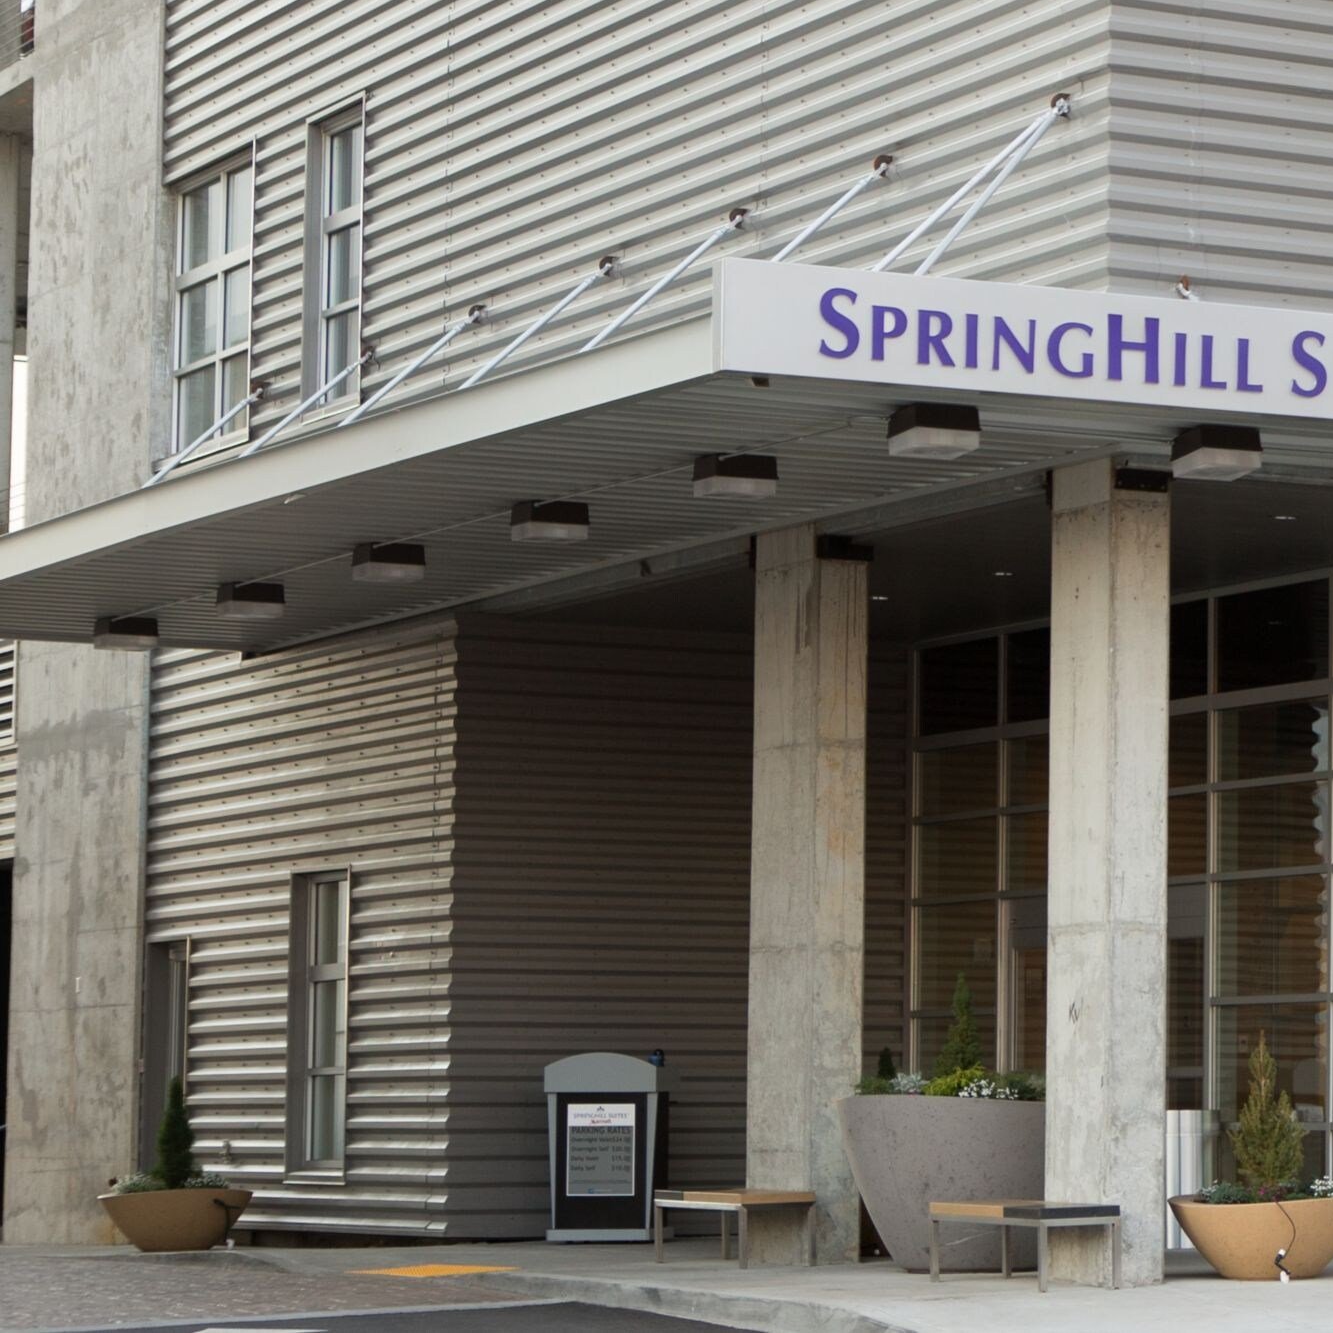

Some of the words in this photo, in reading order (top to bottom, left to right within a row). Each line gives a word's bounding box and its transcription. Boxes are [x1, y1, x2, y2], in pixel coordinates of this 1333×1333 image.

[819, 287, 1264, 393] SPRINGHILL
[571, 1126, 605, 1135] PARKING
[607, 1126, 631, 1135] RATES
